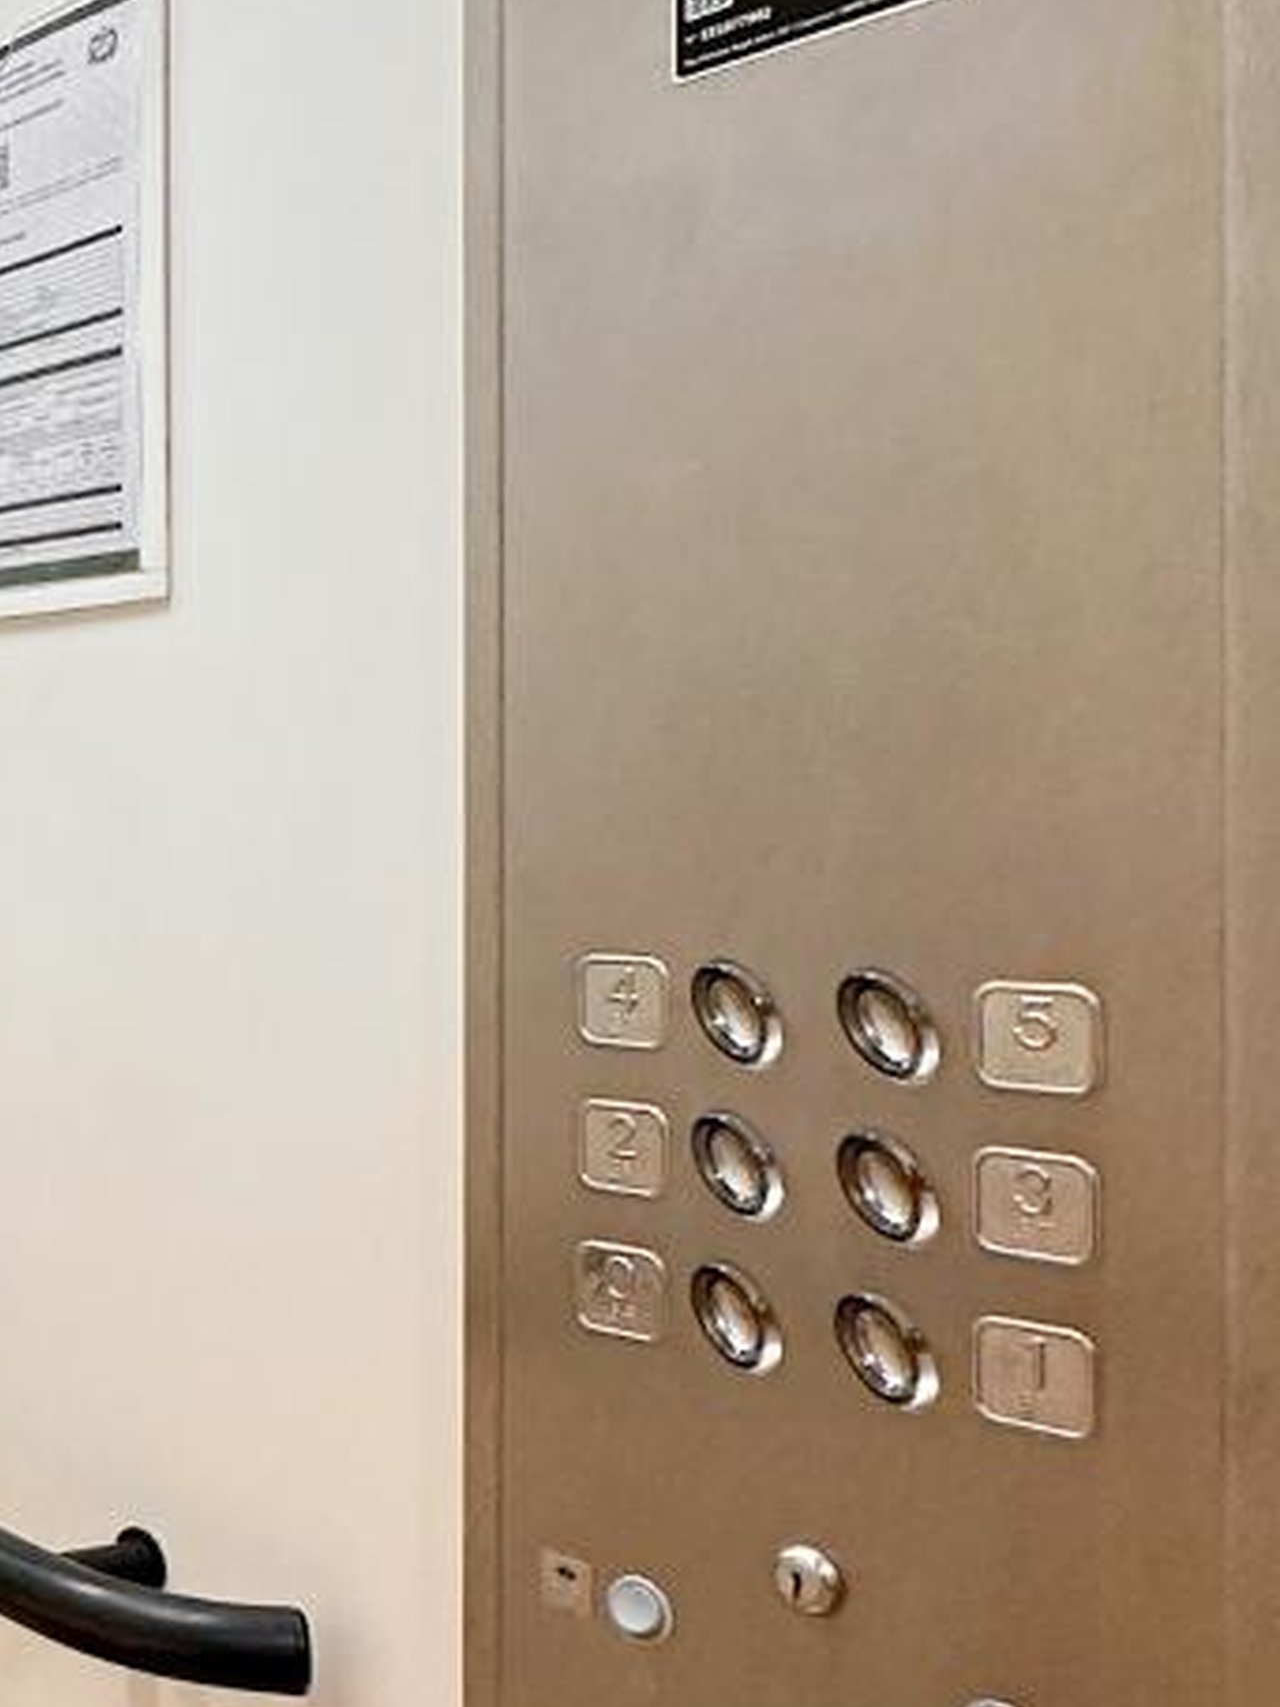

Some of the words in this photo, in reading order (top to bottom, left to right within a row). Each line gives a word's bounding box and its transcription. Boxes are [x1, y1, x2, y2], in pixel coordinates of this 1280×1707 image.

[608, 965, 640, 1013] 4
[1013, 994, 1057, 1050] 5
[607, 1112, 640, 1158] 2
[1014, 1163, 1053, 1218] 3
